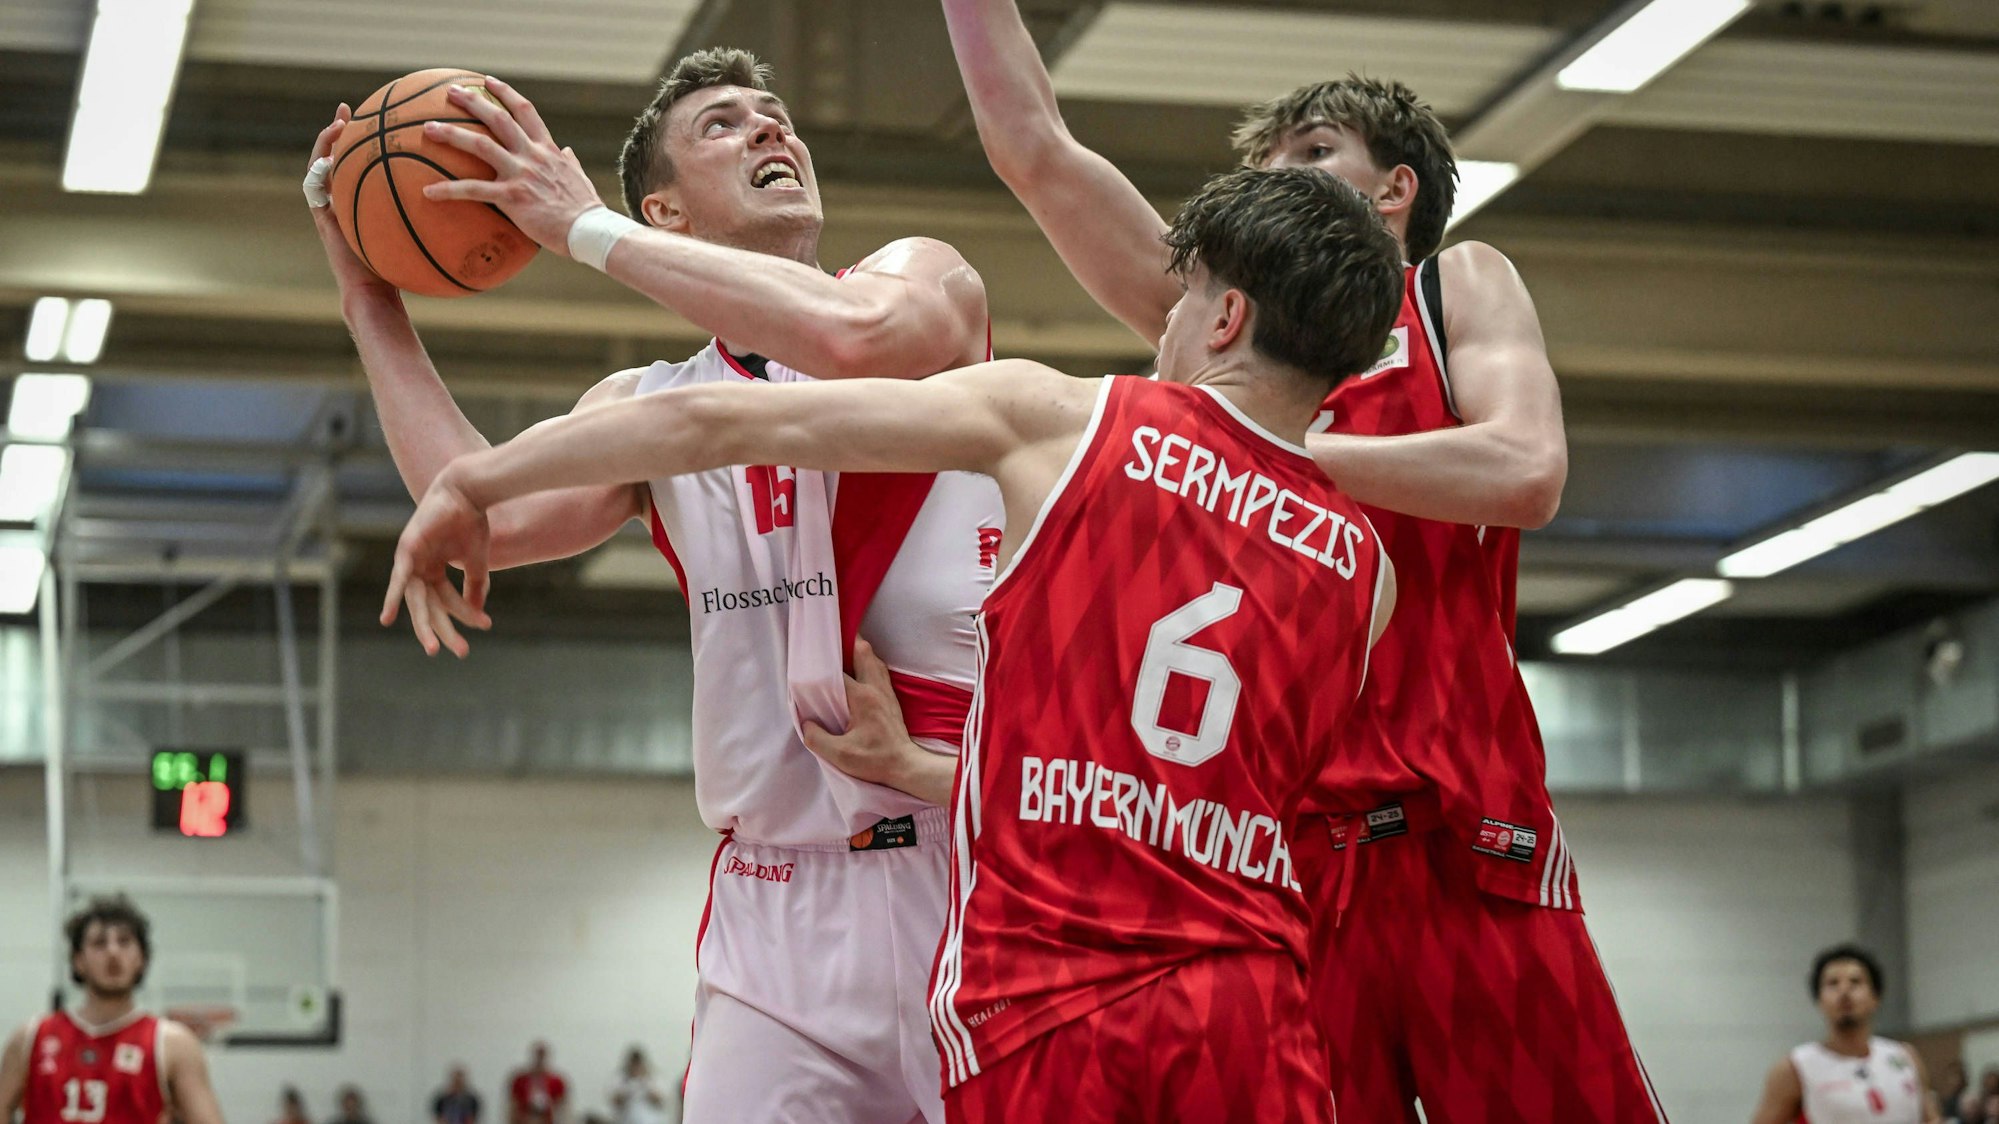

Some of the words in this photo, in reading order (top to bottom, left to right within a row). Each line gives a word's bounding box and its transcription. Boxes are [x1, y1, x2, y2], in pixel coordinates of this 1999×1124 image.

[745, 464, 796, 535] 15
[1124, 425, 1364, 580] SERMPEZIS
[1131, 581, 1243, 767] 6
[877, 823, 911, 832] SPALDING
[1019, 756, 1166, 846] BAYERN
[723, 856, 795, 883] SPALDING
[60, 1079, 108, 1123] 13
